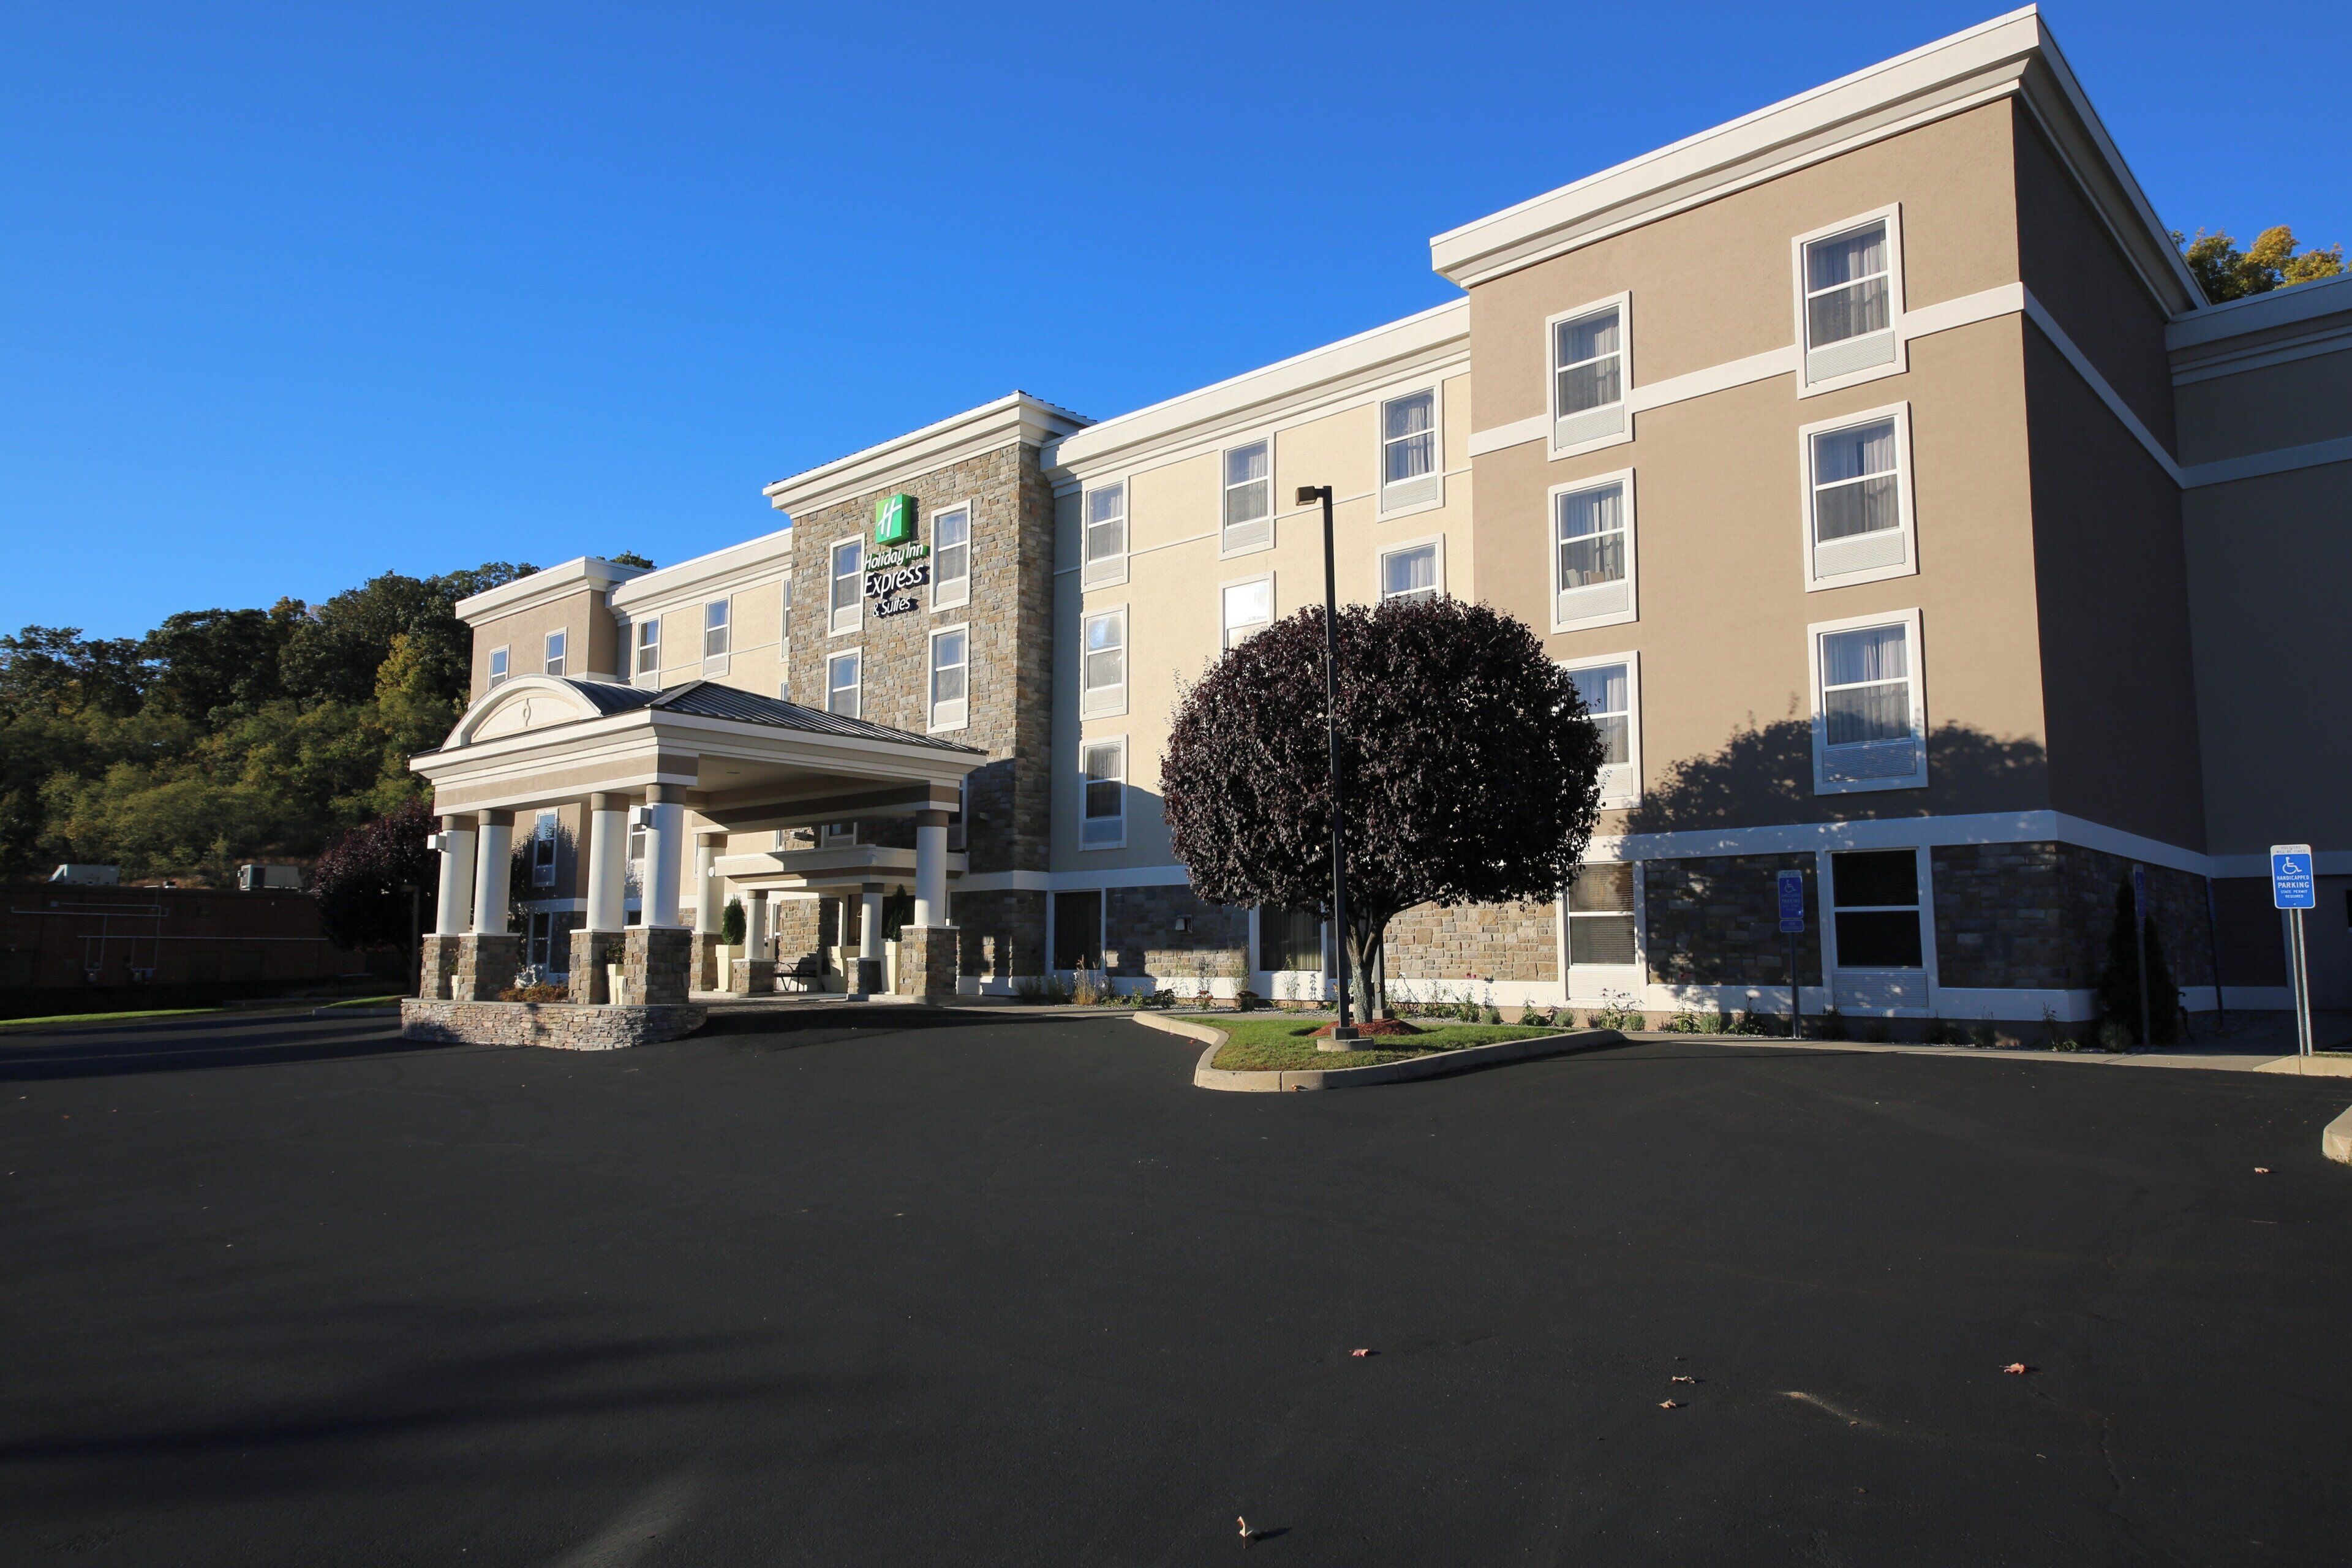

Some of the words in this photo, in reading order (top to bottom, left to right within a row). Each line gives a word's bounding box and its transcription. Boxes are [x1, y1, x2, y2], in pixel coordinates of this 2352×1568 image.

[865, 548, 905, 571] Holiday
[906, 541, 923, 559] Inn
[864, 564, 924, 599] Express
[872, 602, 879, 617] &
[881, 597, 911, 615] Suites
